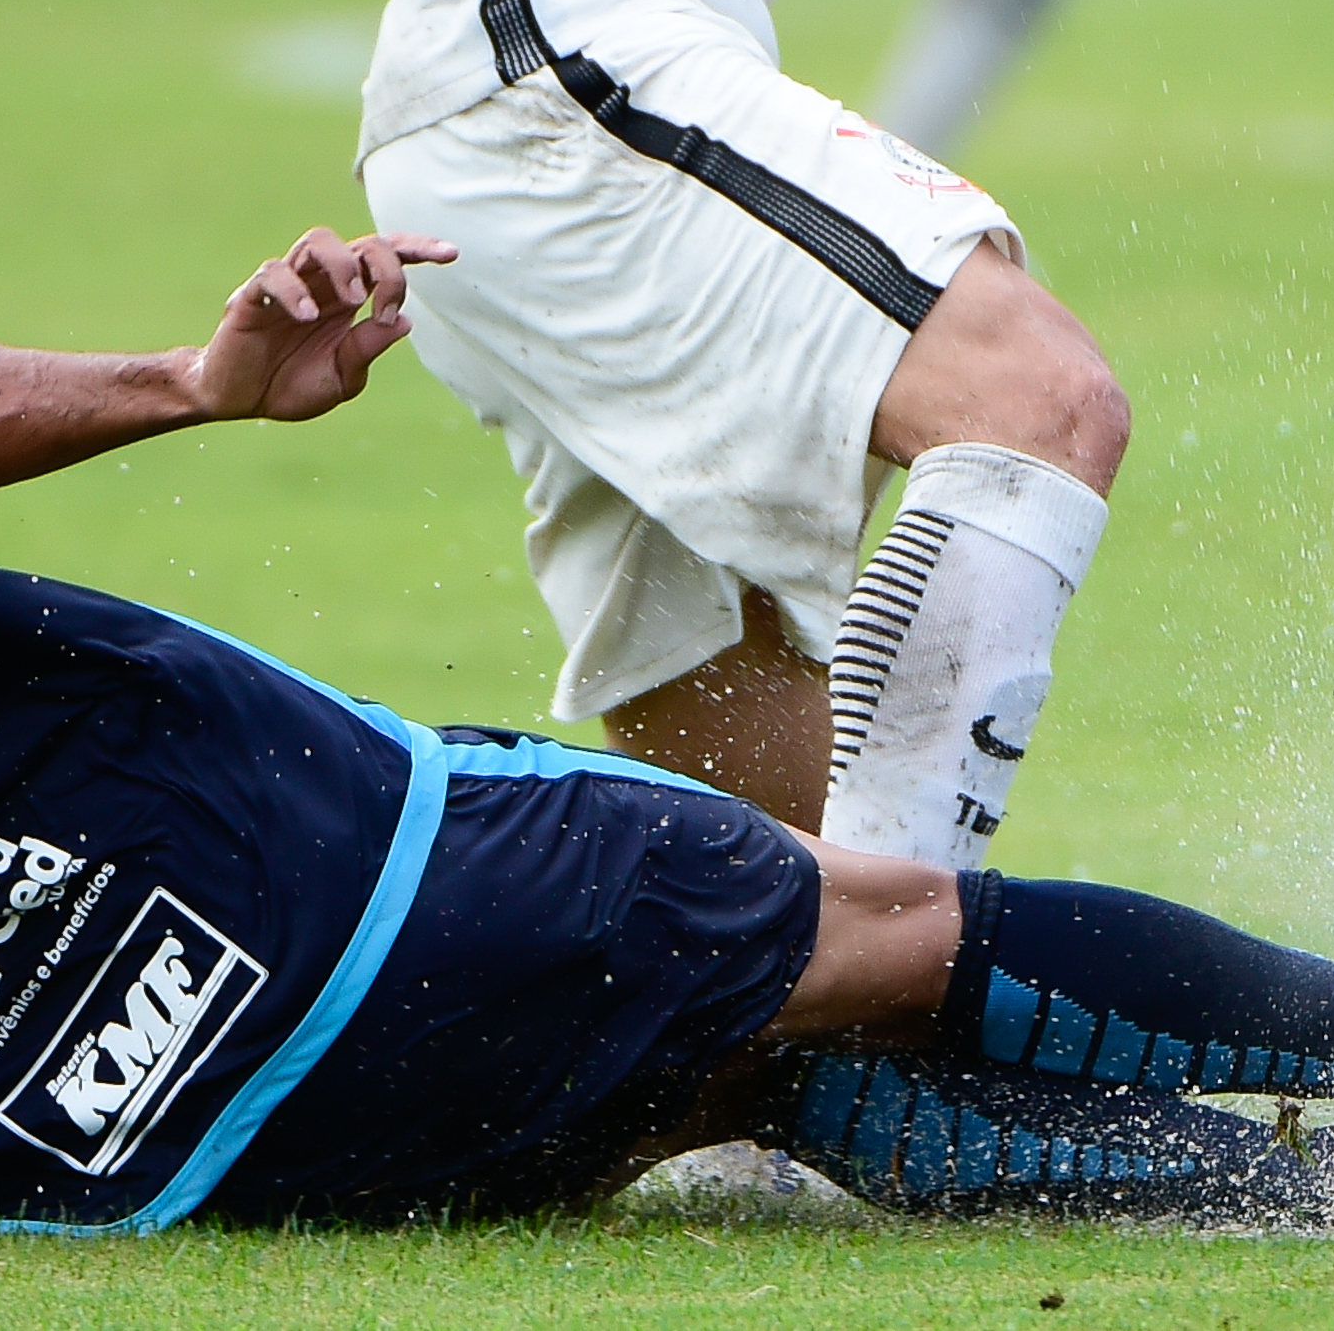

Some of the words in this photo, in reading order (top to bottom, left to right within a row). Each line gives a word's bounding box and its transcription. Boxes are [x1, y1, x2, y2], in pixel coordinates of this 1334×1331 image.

[37, 965, 51, 980] e
[44, 862, 116, 967] benefícios
[45, 1030, 96, 1097] Baterias
[57, 936, 197, 1136] KMF
